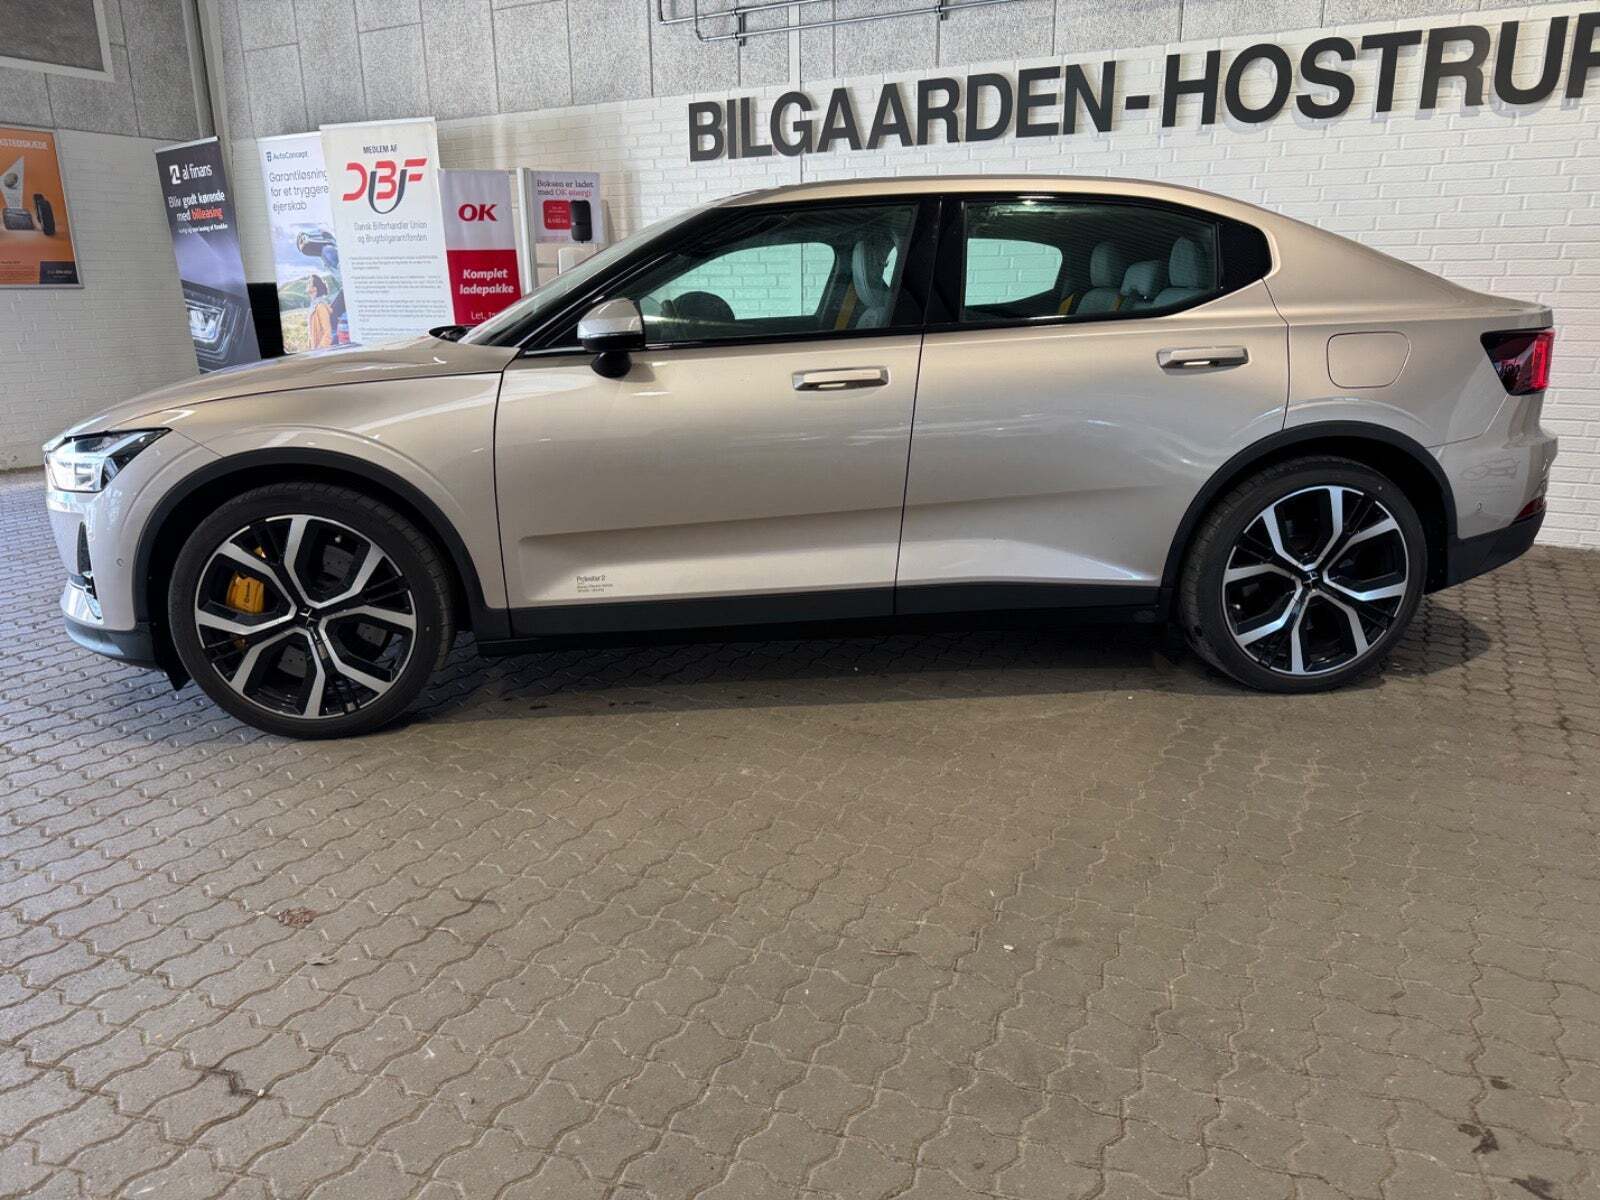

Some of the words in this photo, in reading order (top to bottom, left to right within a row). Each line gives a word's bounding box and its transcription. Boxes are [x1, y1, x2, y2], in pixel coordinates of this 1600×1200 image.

[363, 144, 389, 154] MEDLEM
[390, 143, 398, 153] AF
[189, 162, 213, 179] finans
[270, 187, 281, 198] for
[282, 186, 292, 197] et
[293, 185, 329, 199] tryggere
[182, 192, 198, 209] godt
[273, 200, 307, 215] ejerskab
[176, 208, 191, 222] med
[458, 203, 498, 222] OK
[463, 267, 508, 281] Komplet
[460, 283, 515, 297] ladepakke
